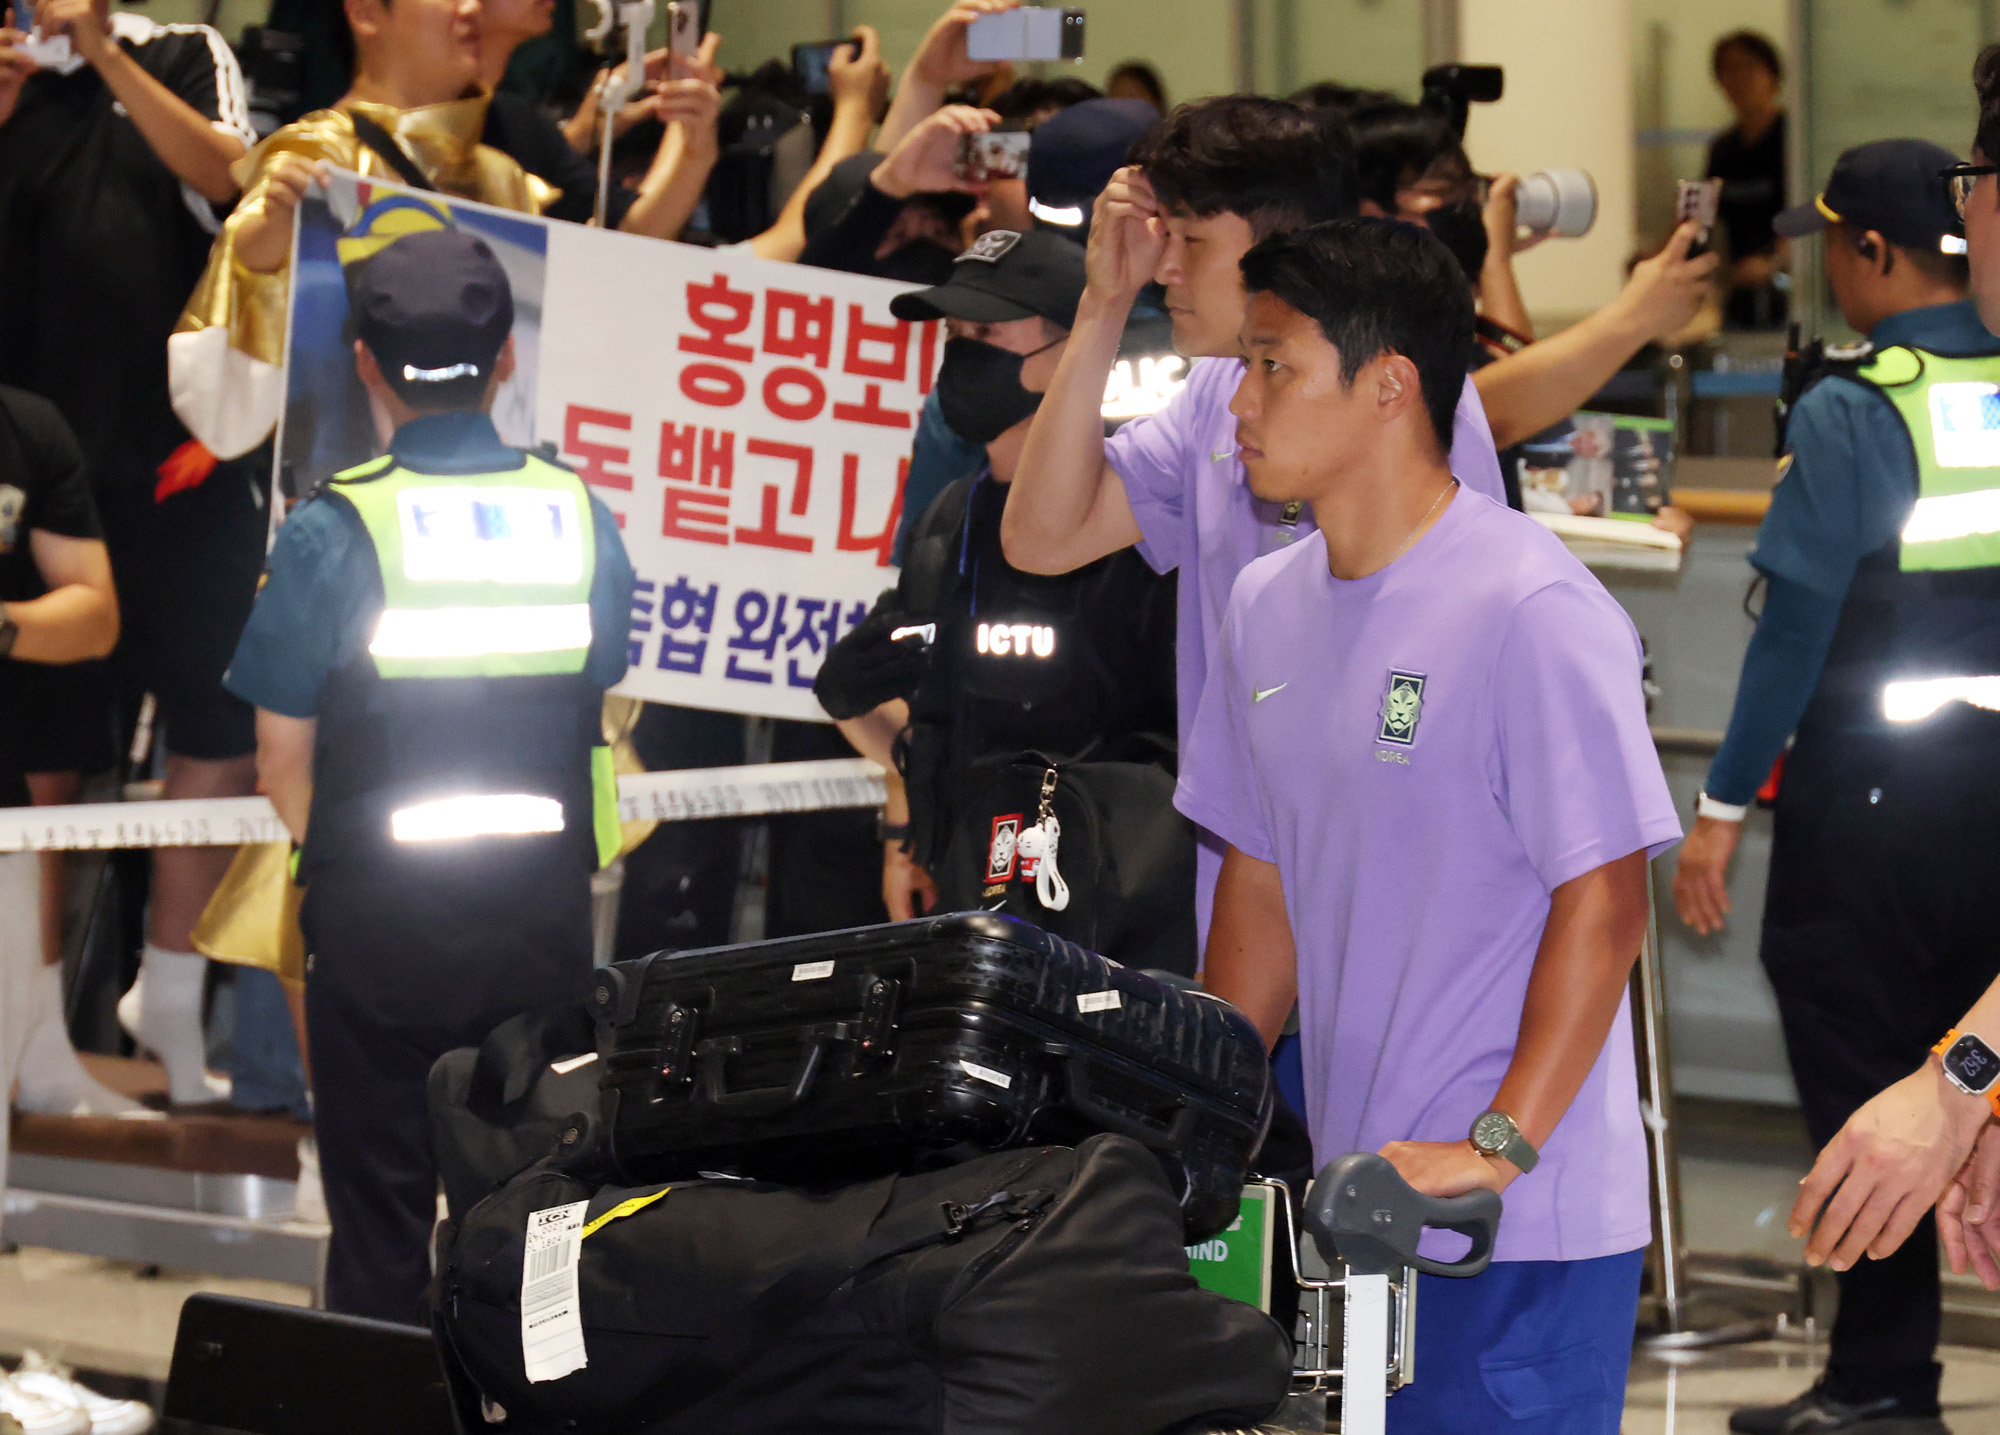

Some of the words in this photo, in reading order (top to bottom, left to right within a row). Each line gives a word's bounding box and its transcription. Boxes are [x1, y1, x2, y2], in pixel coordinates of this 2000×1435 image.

[678, 273, 938, 429] 홍명보
[658, 420, 814, 553] 뱉고
[725, 590, 870, 689] 완전
